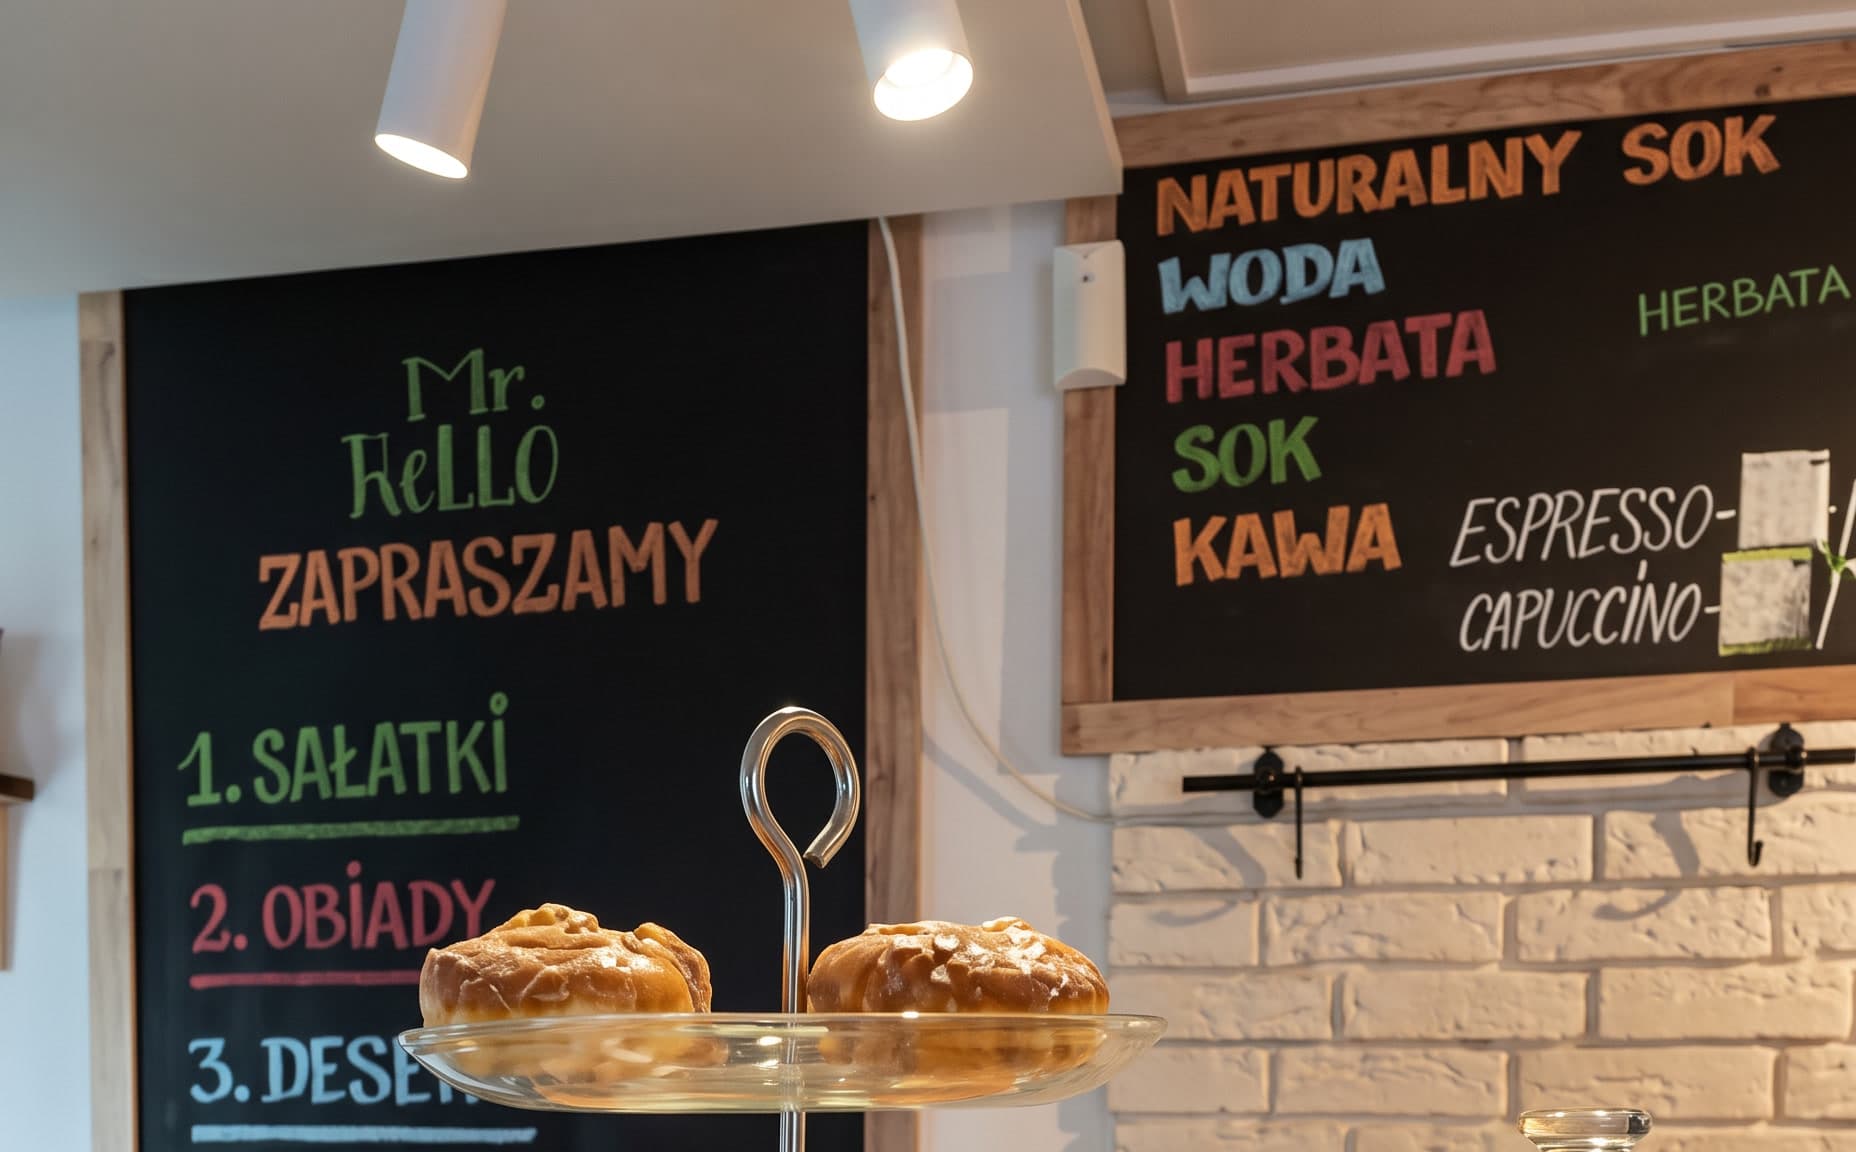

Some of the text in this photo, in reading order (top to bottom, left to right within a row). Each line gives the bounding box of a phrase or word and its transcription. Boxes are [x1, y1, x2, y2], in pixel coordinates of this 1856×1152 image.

[1155, 114, 1781, 236] NATURALNY SOK
[1157, 237, 1386, 314] WODA
[1638, 264, 1852, 336] HERBATA
[402, 347, 545, 422] Mr.
[1163, 309, 1497, 404] HERBATA
[1172, 415, 1322, 492] SOK
[257, 518, 719, 631] ZAPRASZAMY
[1173, 502, 1402, 587] KAWA
